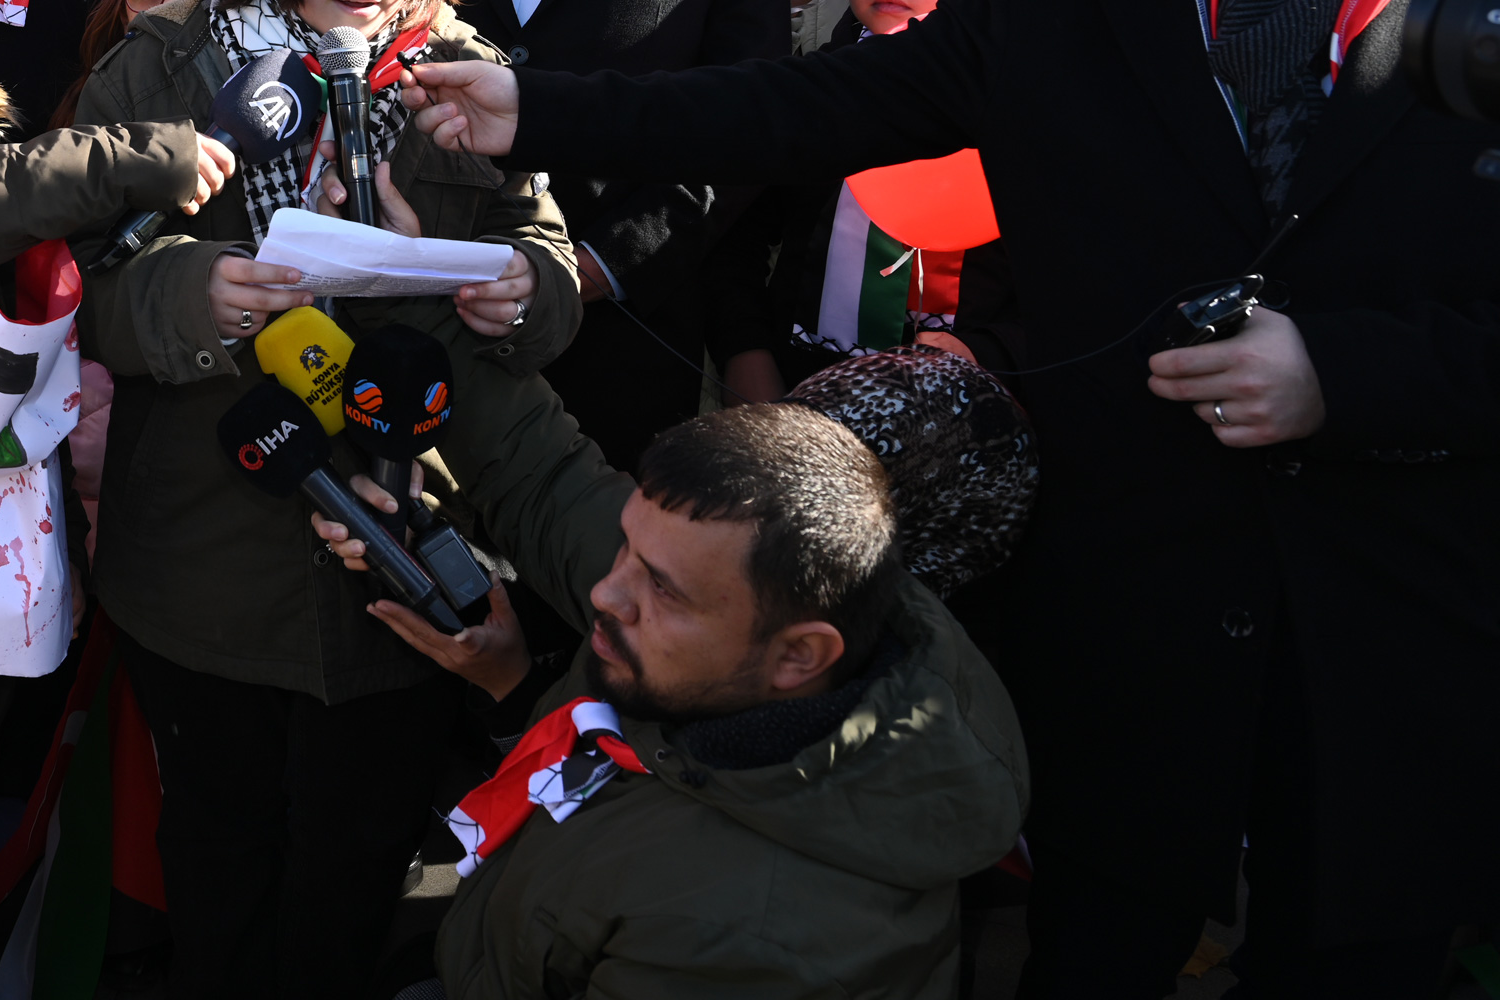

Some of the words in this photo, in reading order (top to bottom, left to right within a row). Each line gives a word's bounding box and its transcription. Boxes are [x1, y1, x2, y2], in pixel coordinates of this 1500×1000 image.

[312, 362, 340, 386] KONYA
[345, 404, 390, 434] KONTV
[413, 406, 451, 435] KONTV
[255, 420, 300, 456] İHA
